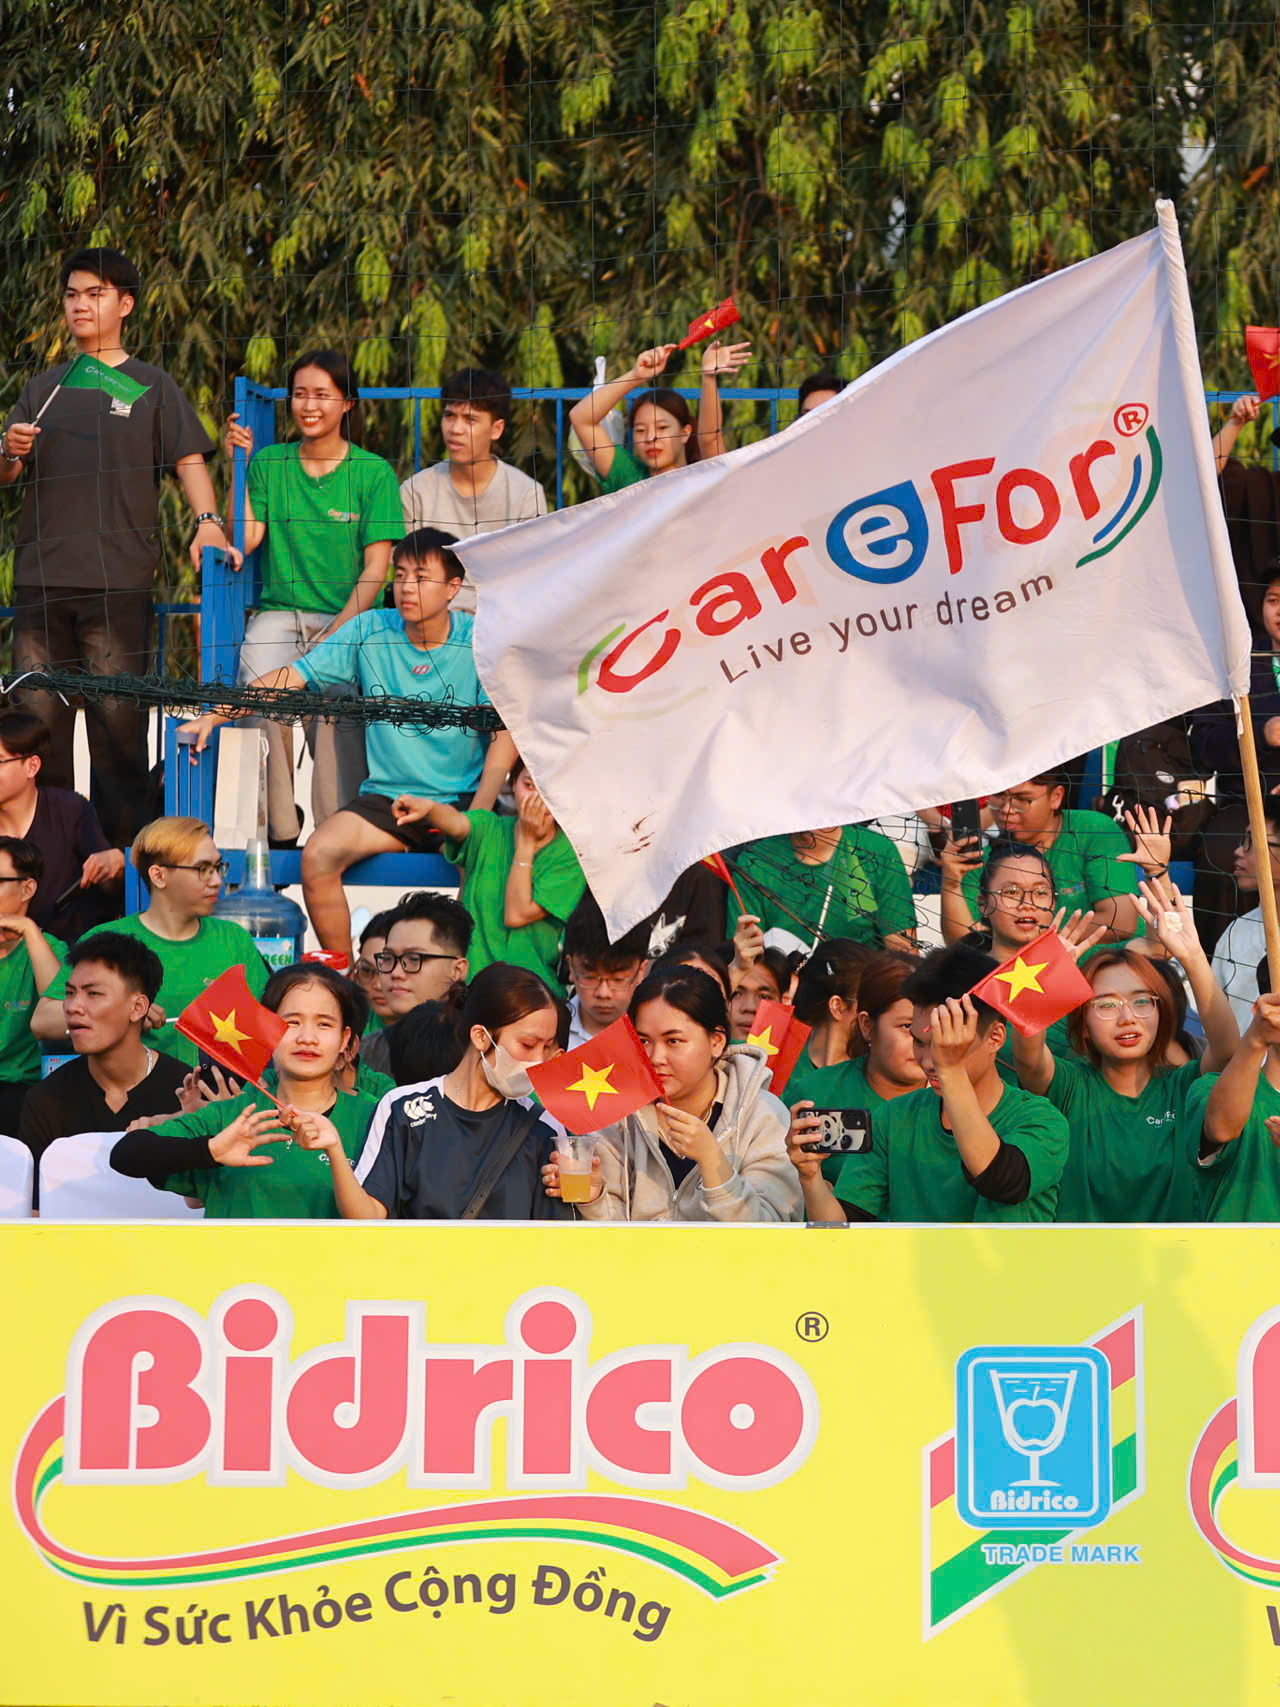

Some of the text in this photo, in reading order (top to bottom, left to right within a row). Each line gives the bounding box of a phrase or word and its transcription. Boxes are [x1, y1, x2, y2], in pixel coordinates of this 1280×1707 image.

[720, 573, 1054, 684] Live your dream
[75, 1295, 808, 1480] Bidrico
[989, 1488, 1080, 1512] Bidrico
[983, 1545, 1140, 1564] TRADE MARK
[83, 1564, 671, 1646] Vì Sức Khỏe Cộng Đồng
